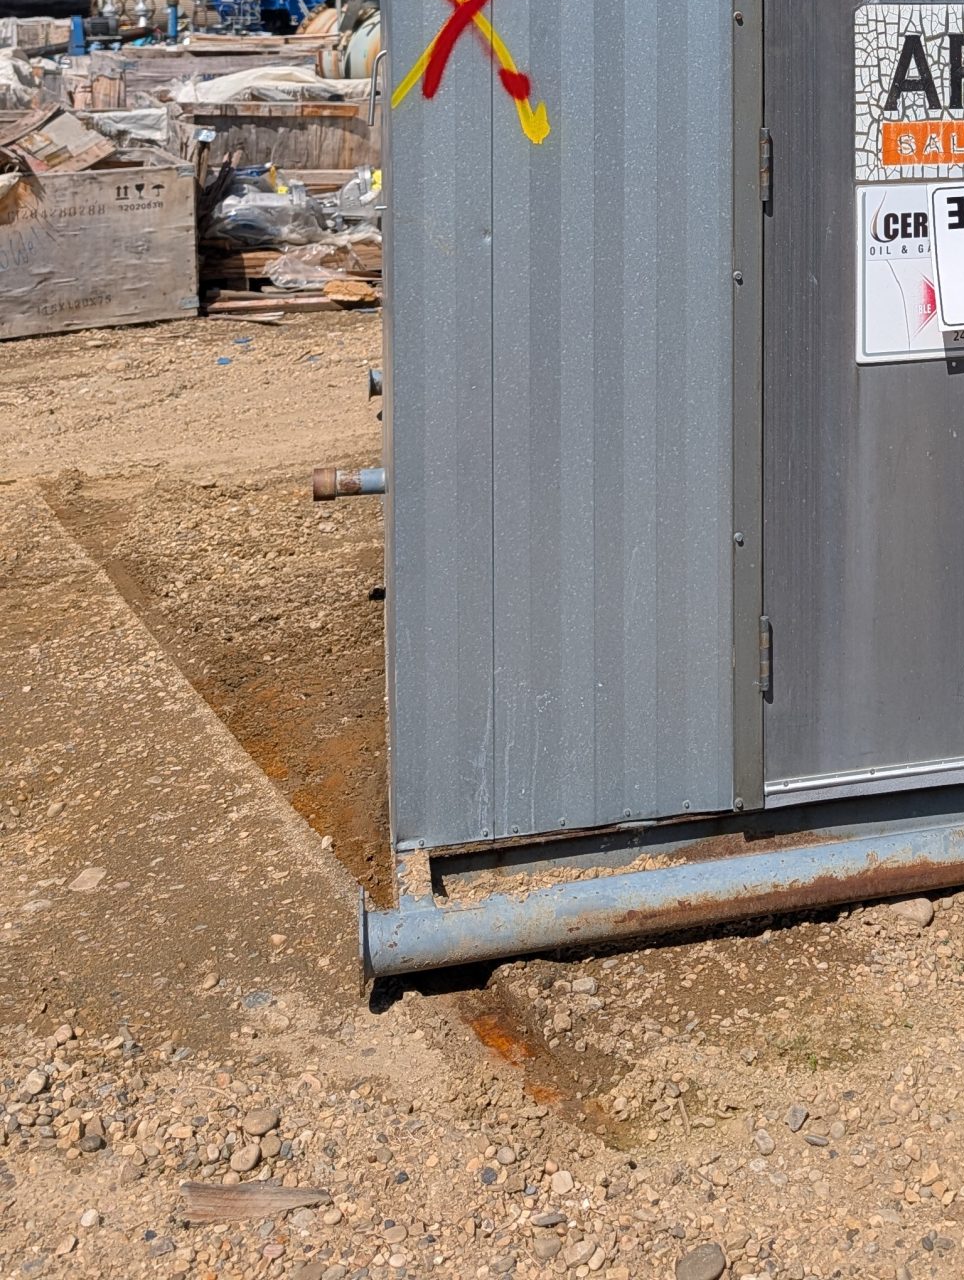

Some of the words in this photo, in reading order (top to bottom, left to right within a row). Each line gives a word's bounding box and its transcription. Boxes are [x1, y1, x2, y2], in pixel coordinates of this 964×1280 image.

[884, 212, 928, 240] CER
[870, 246, 892, 256] OIL
[901, 244, 908, 254] &
